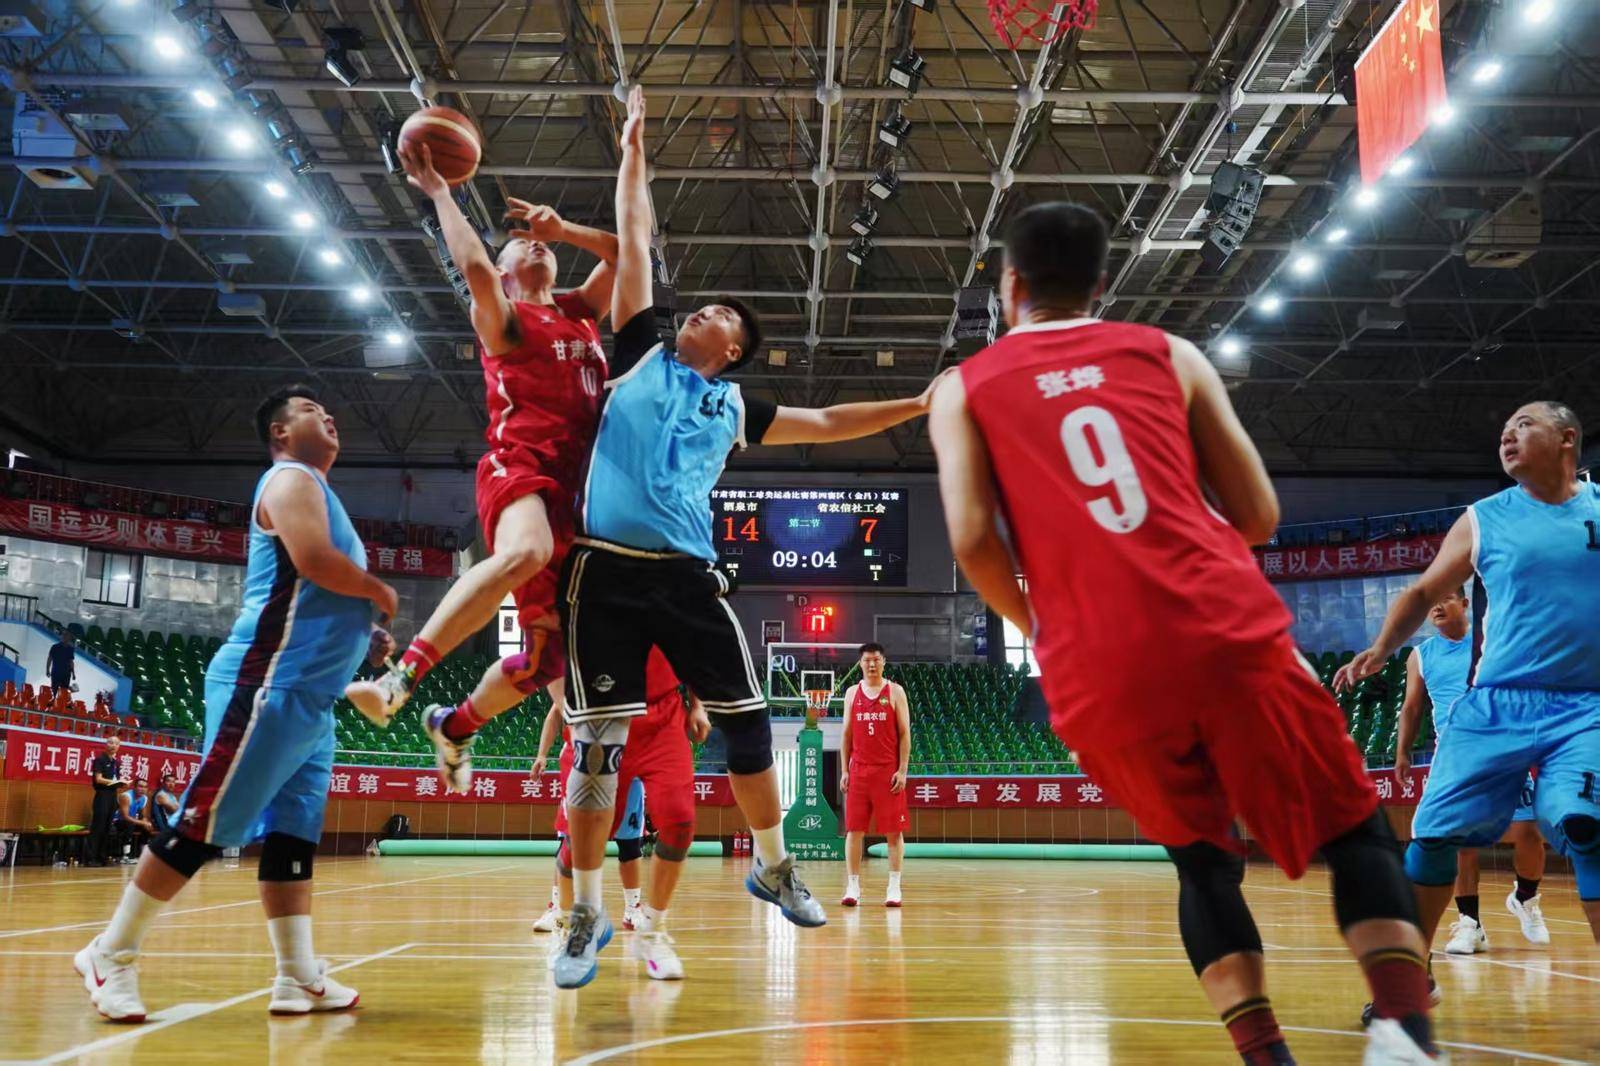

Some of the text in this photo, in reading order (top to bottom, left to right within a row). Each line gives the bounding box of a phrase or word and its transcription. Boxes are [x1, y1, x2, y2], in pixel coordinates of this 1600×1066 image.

[580, 366, 597, 396] 10
[1060, 406, 1148, 534] 9
[723, 502, 758, 512] 酒泉市
[817, 503, 886, 513] 省农信社工会
[29, 504, 224, 553] 国运兴则体育兴
[723, 516, 759, 541] 14
[788, 518, 820, 528] 第二节
[860, 518, 879, 543] 7
[364, 548, 423, 571] 育强
[772, 551, 837, 568] 09:04
[1252, 541, 1437, 575] 展以人民为中心
[856, 712, 887, 721] 甘肃农信
[868, 723, 875, 736] 5
[23, 742, 149, 781] 职工同心赛场
[331, 773, 497, 798] 谊第一赛格
[693, 781, 714, 800] 平
[915, 783, 1103, 802] 丰富发展党
[628, 812, 639, 830] 4
